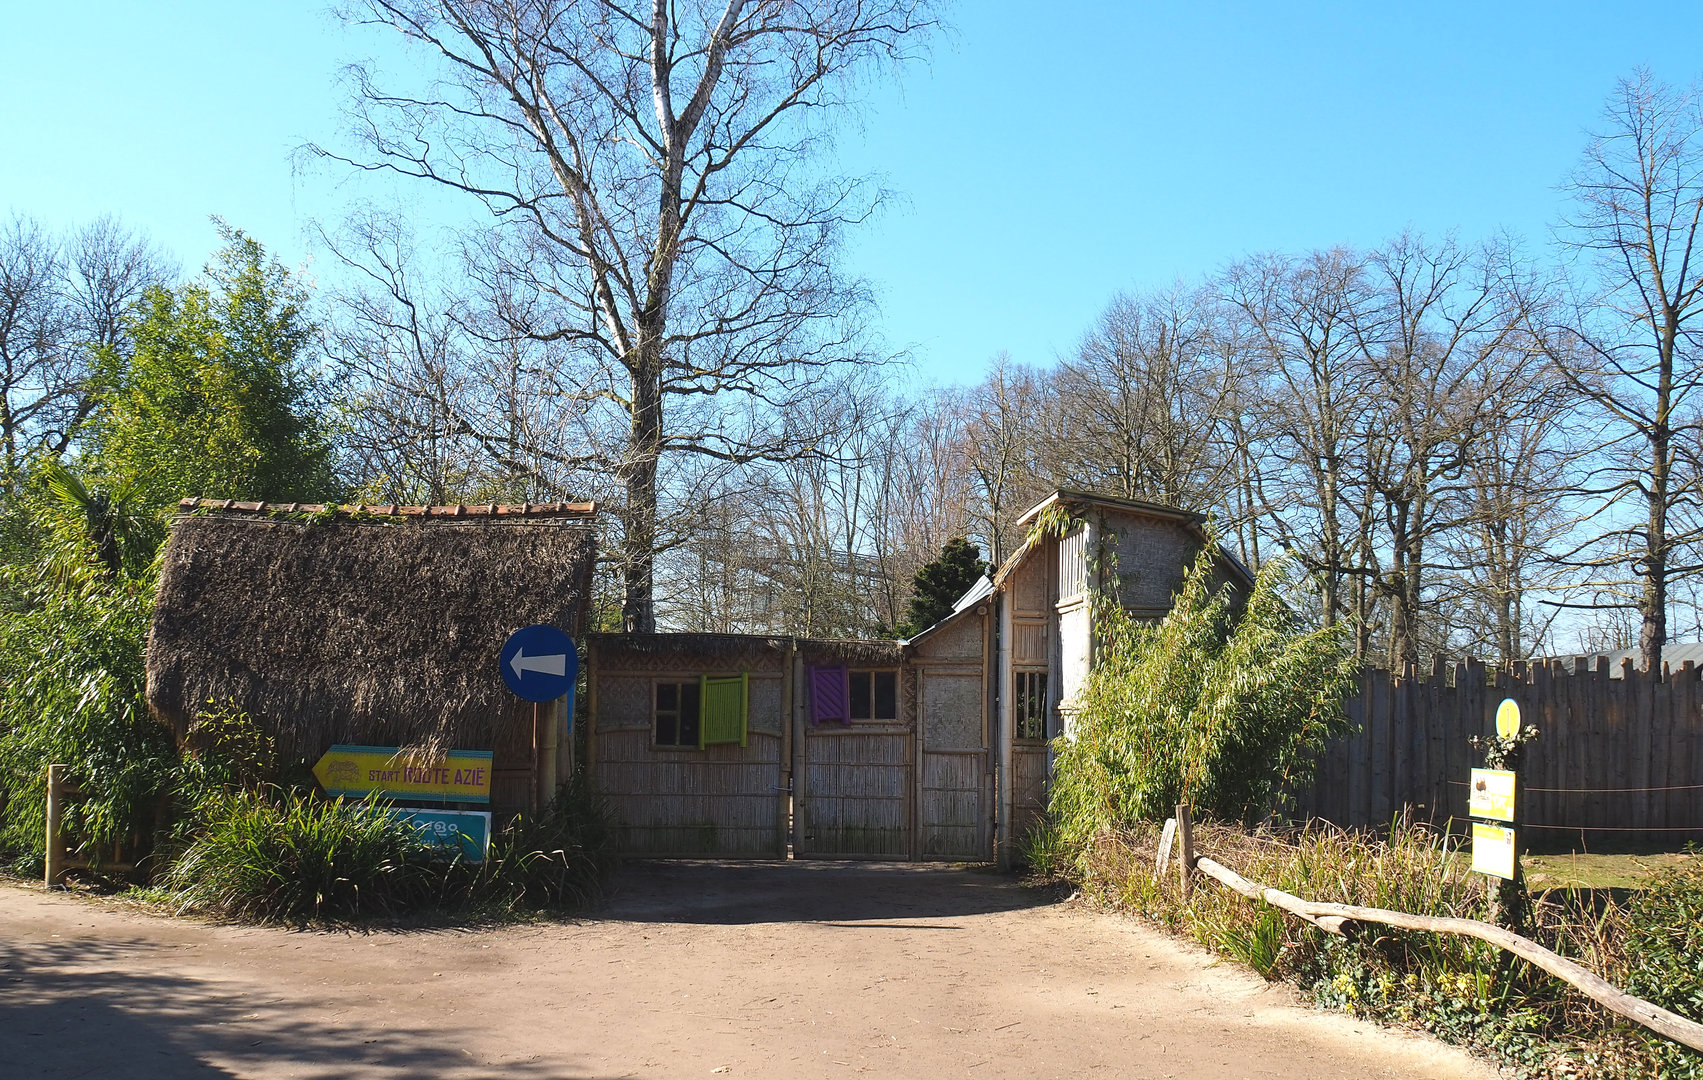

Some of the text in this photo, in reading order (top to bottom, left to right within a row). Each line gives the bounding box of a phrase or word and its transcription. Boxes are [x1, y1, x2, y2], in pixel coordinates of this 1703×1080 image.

[368, 766, 486, 786] START ROUTE AZIË
